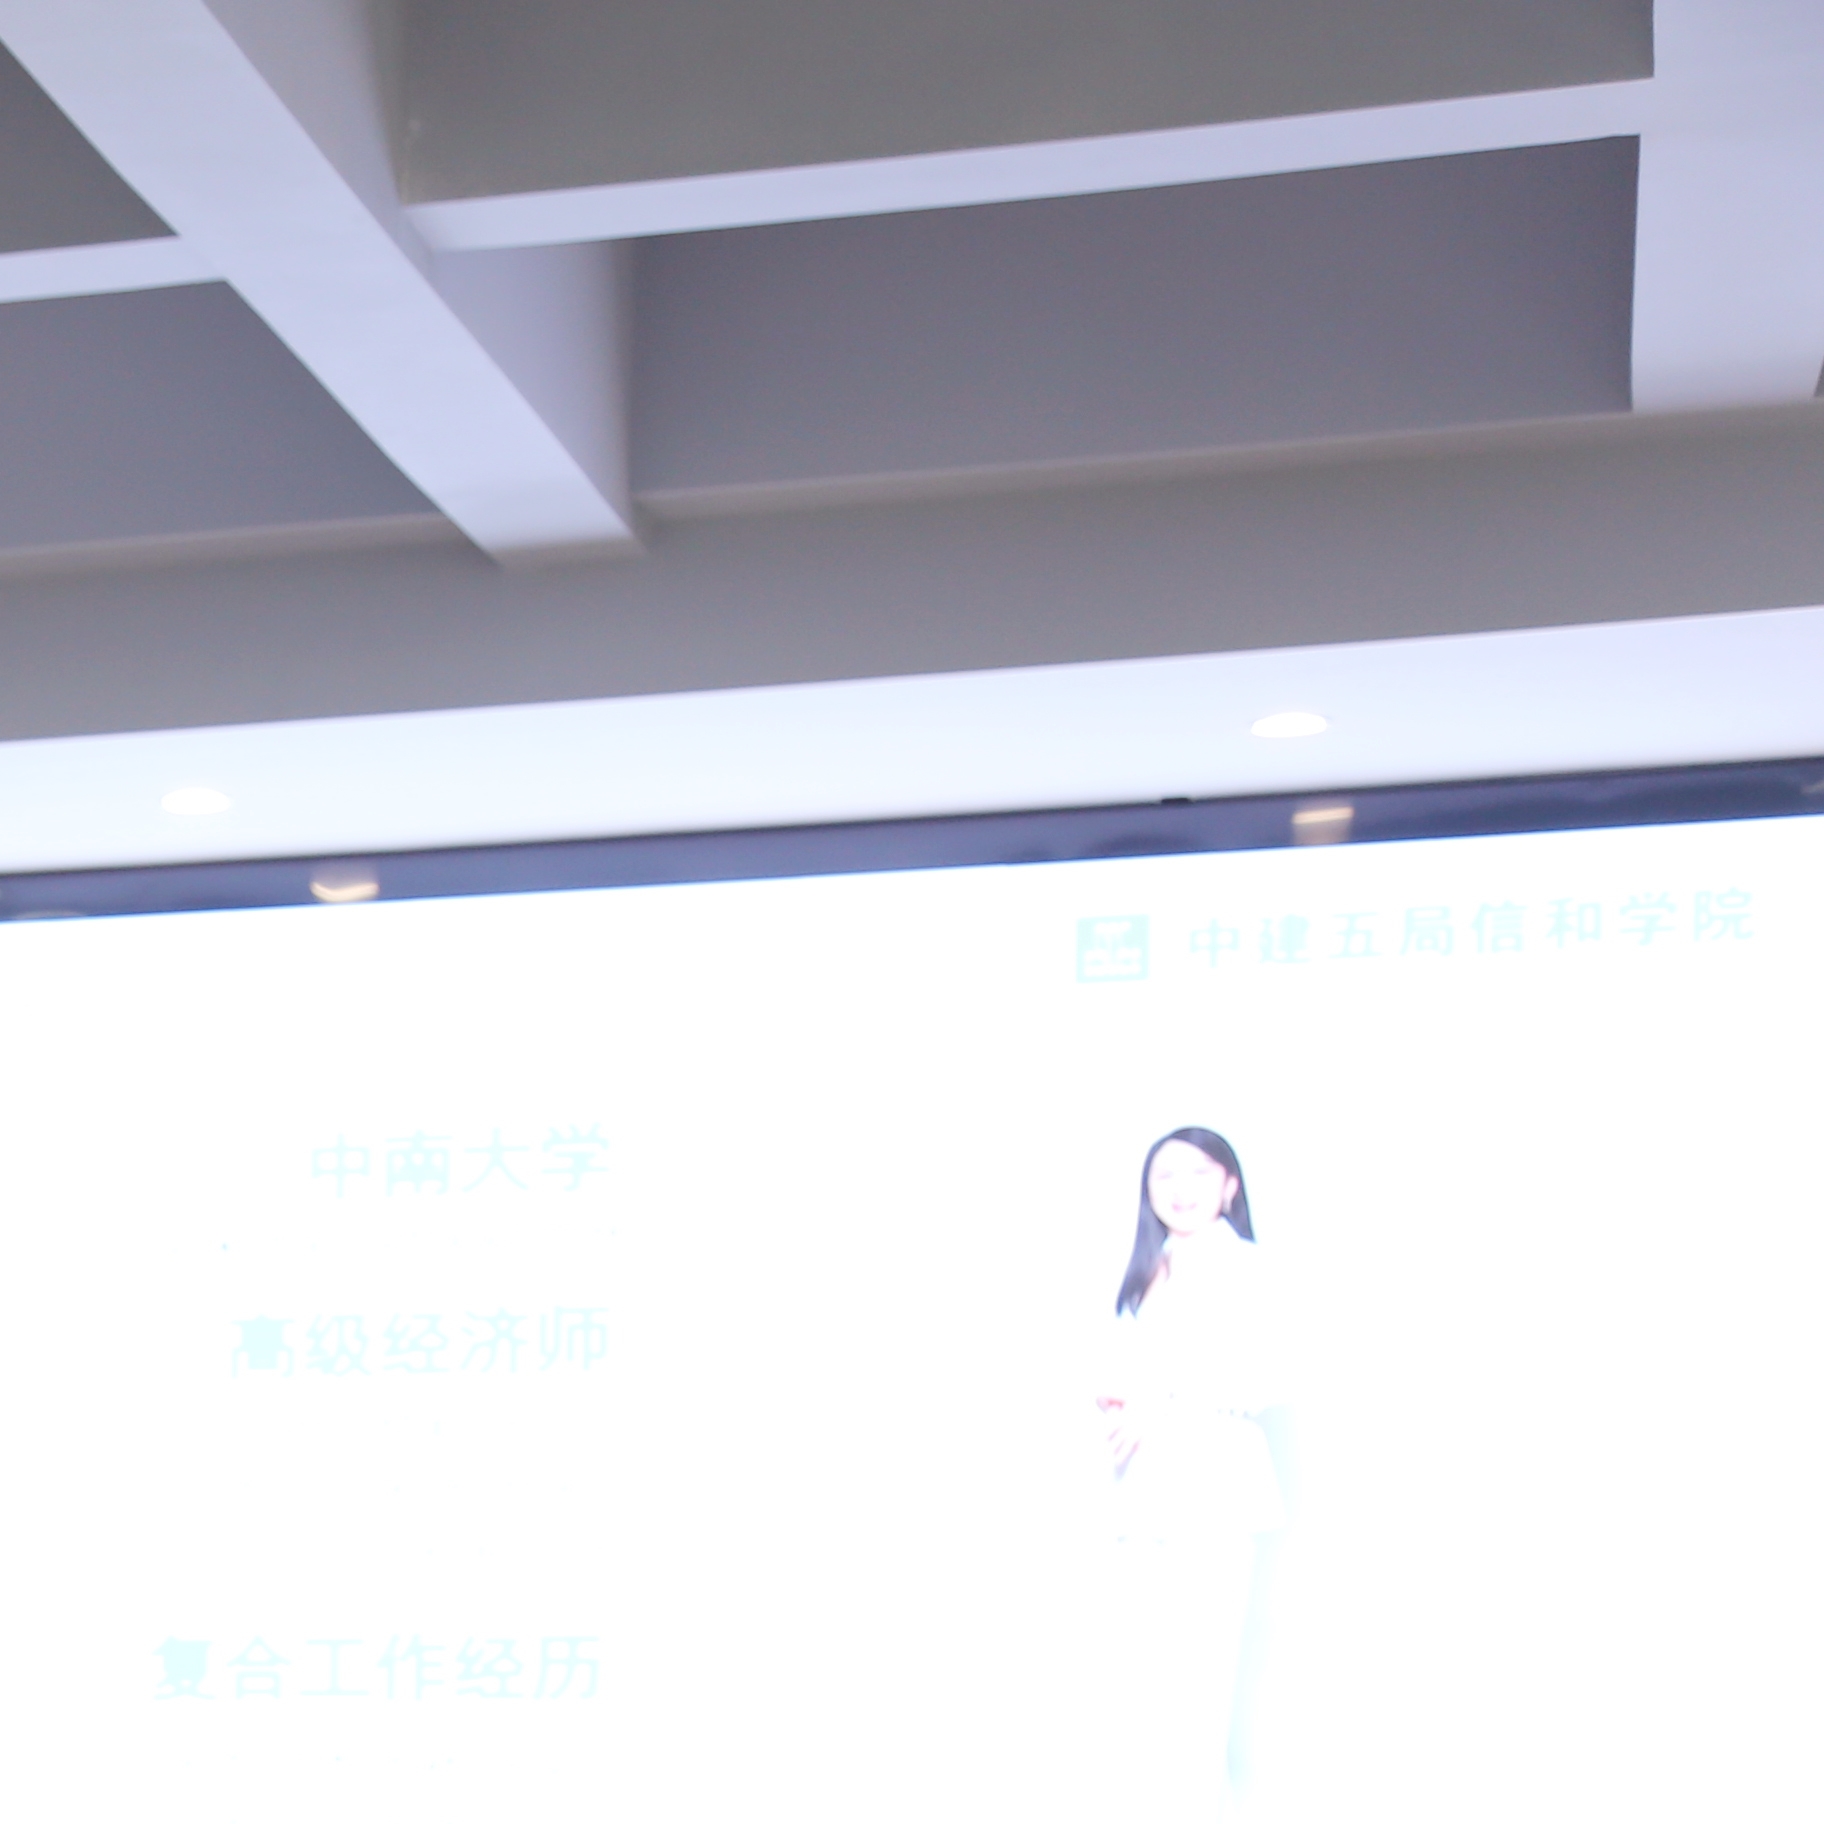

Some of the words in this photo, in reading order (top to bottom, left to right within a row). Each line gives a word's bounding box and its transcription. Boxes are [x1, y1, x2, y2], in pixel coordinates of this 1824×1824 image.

[1188, 886, 1755, 968] 中建五局信和学院
[311, 1122, 610, 1199] 中南大学
[230, 1305, 609, 1378] 高级经济师
[151, 1633, 601, 1702] 复合工作经历
